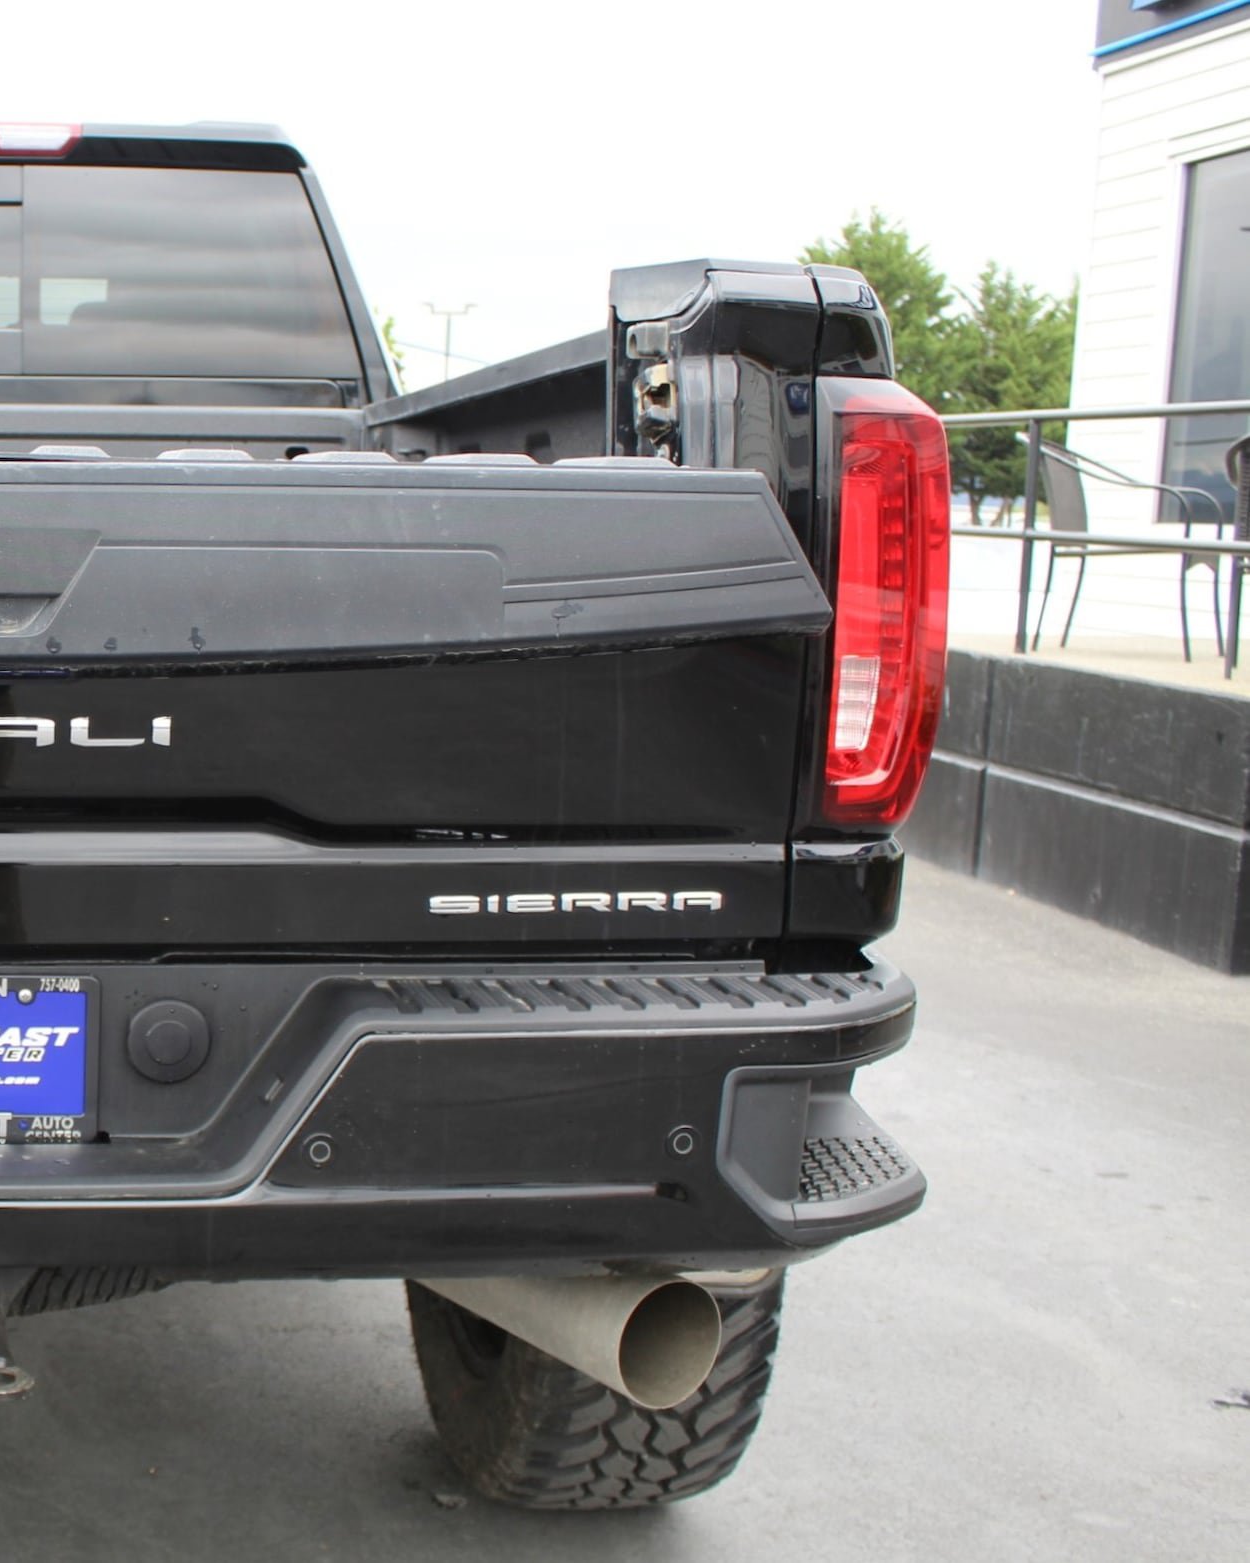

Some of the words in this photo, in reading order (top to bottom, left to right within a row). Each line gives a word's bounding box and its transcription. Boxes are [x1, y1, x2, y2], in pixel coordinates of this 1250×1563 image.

[429, 890, 723, 914] SIERRA
[40, 978, 81, 993] 757-0400
[30, 1116, 74, 1130] AUTO
